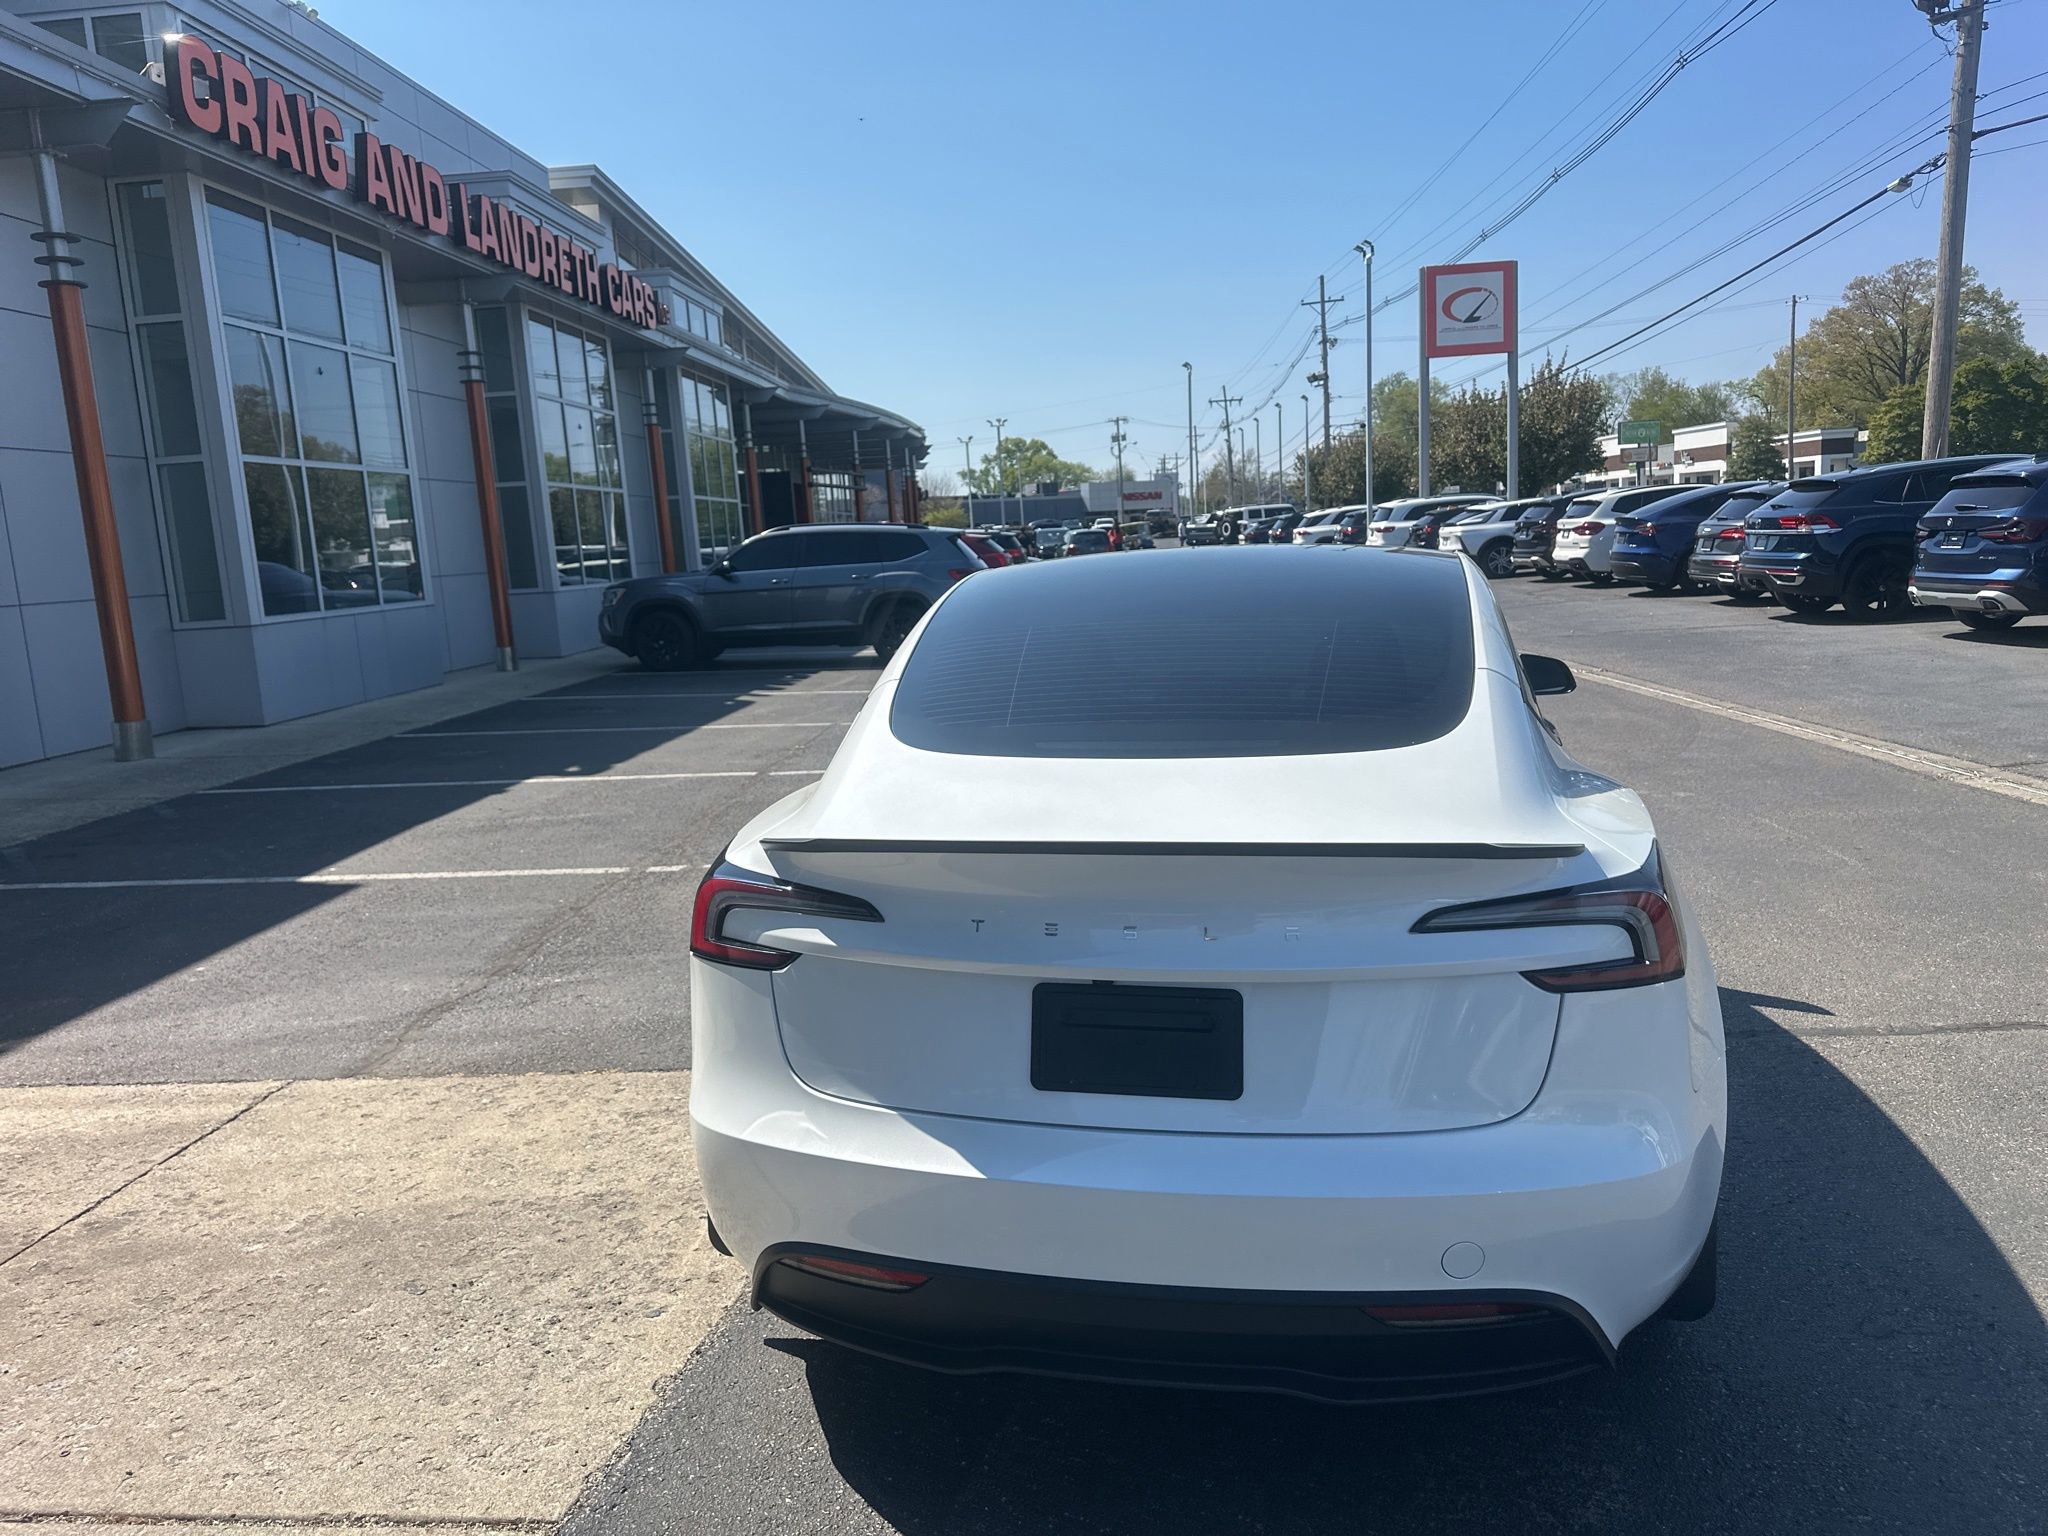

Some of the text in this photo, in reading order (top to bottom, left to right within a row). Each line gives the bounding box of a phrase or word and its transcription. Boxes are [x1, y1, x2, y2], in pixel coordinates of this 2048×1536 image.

[177, 34, 657, 330] CRAIG AND LANDRETH CARS
[1121, 490, 1163, 501] NISSAN
[971, 918, 1300, 941] TESLA
